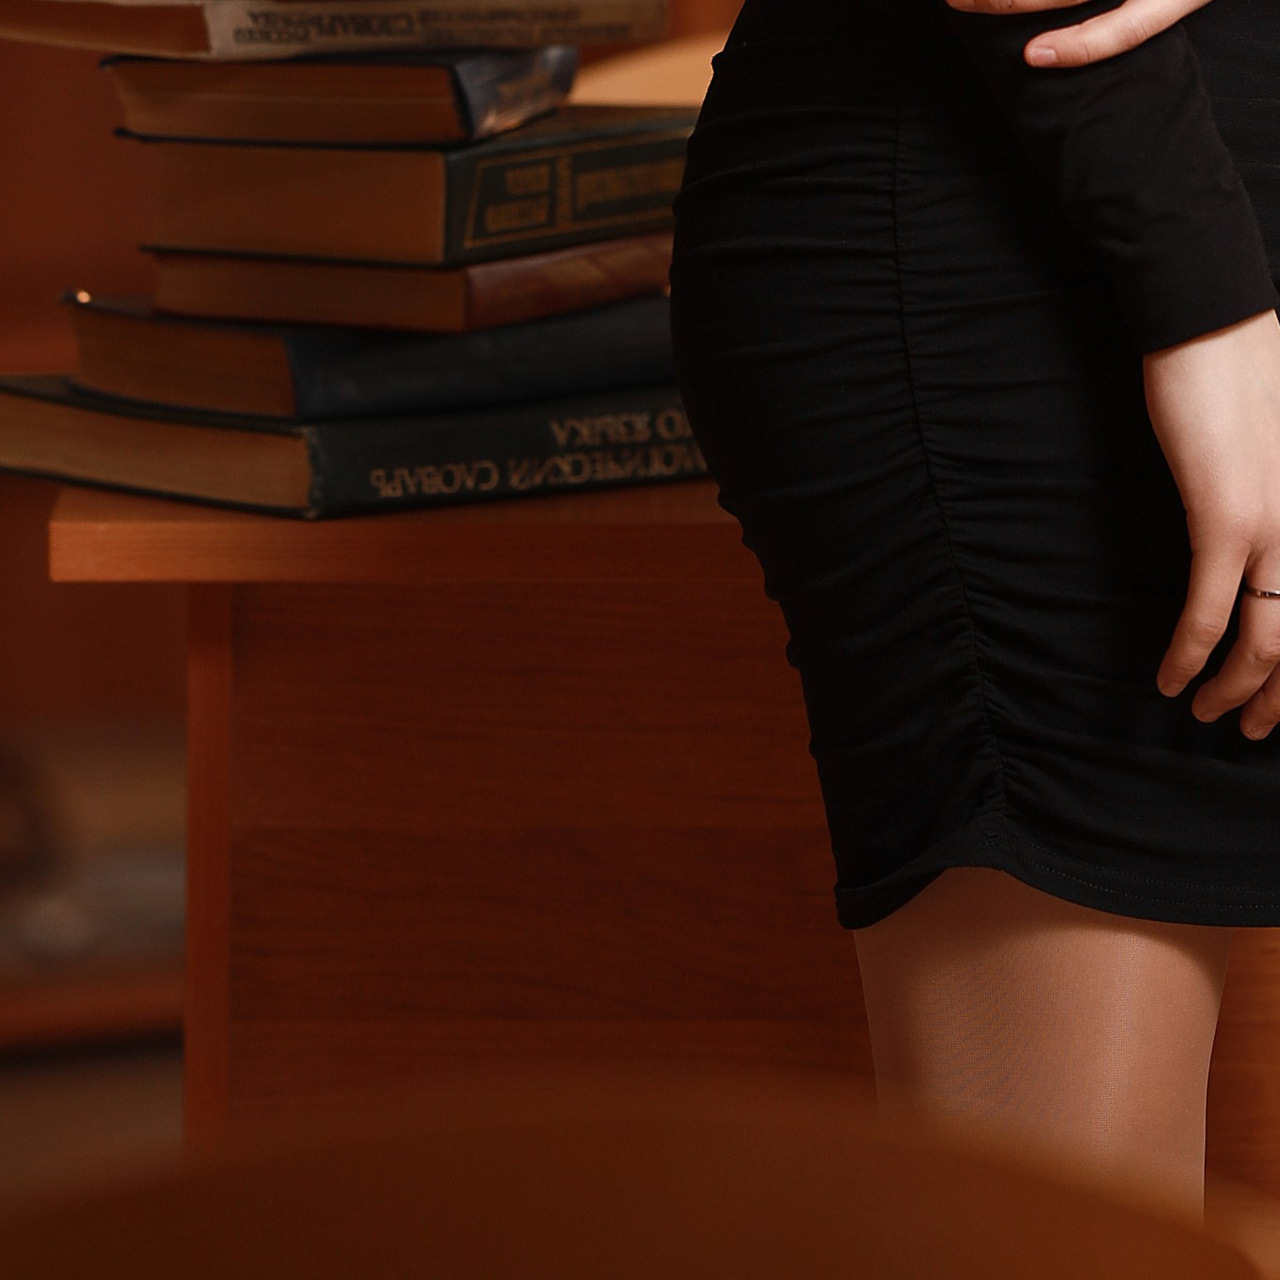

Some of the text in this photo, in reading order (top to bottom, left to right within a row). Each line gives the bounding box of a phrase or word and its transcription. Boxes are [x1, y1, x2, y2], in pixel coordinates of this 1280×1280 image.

[551, 411, 651, 445] ЯЗЫКА
[369, 443, 708, 499] ЛОГИЧЕСКИЙ СЛОВАРЬ
